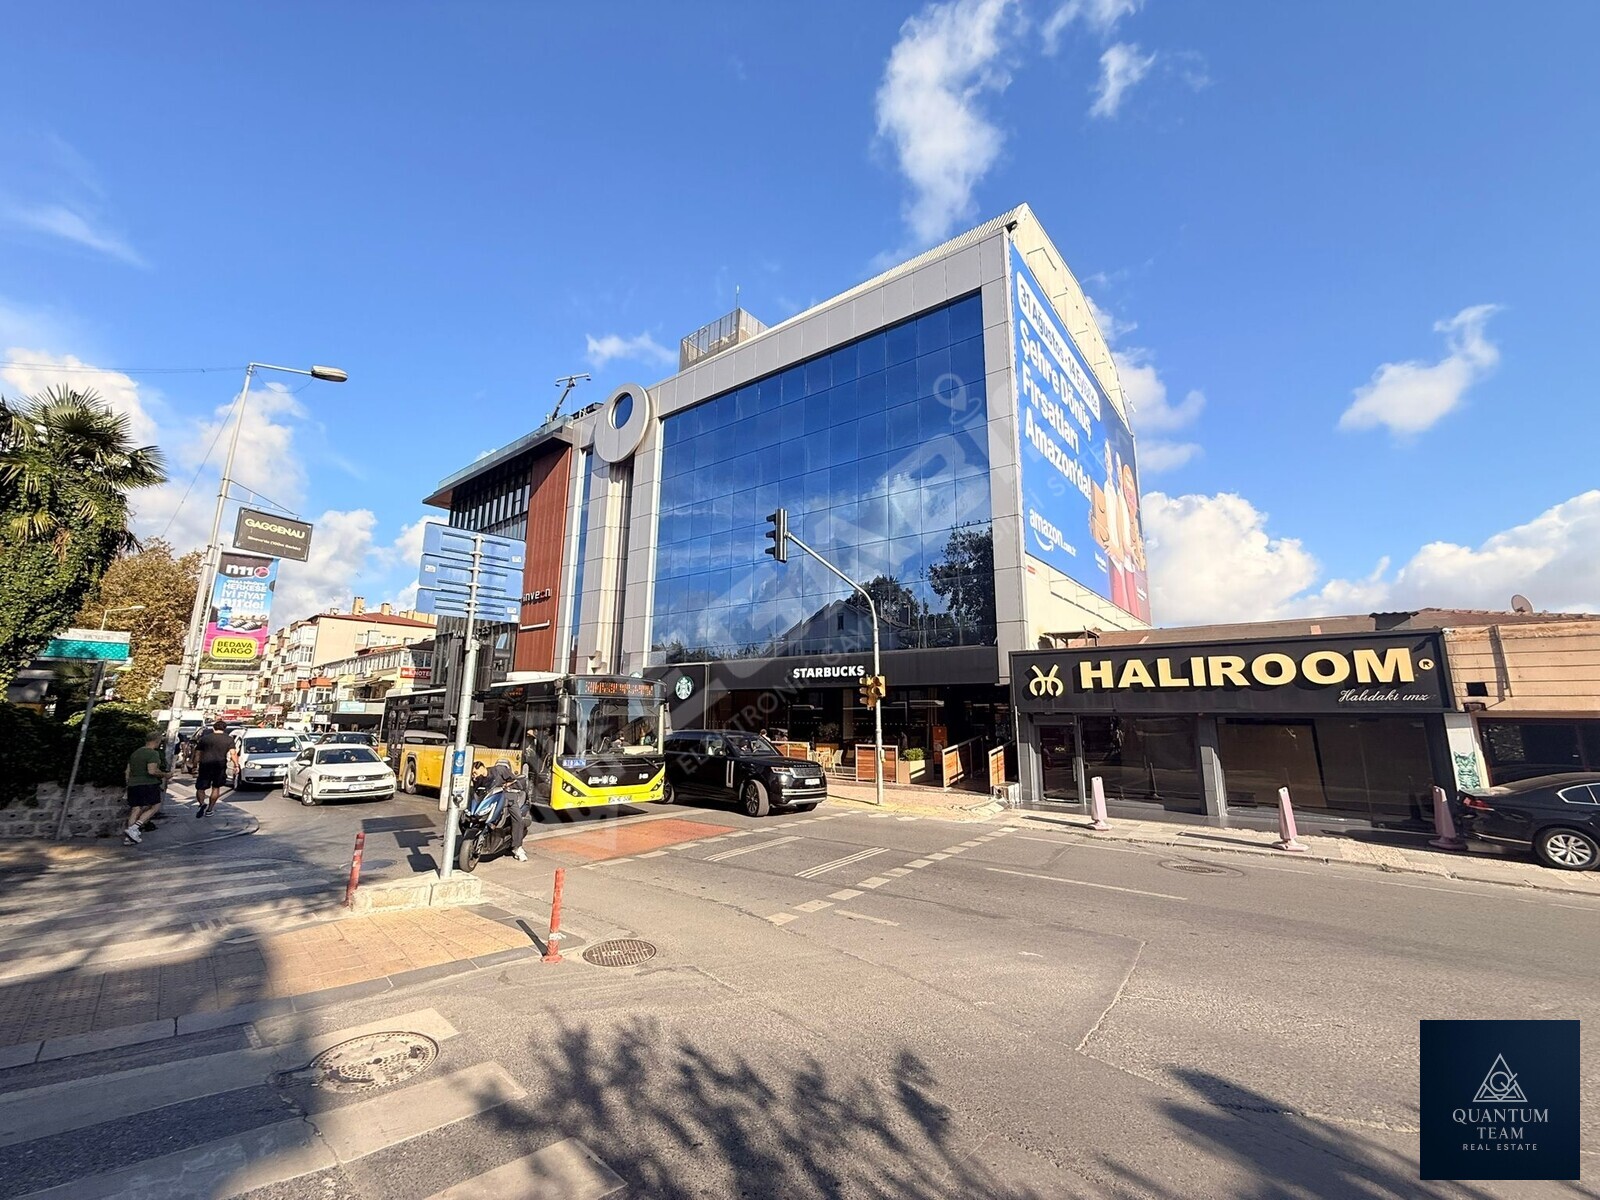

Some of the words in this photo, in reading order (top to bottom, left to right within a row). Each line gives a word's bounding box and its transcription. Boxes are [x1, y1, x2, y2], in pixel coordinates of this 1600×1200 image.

[1020, 319, 1060, 395] Şehre
[1060, 373, 1092, 442] Dönüş
[1022, 361, 1079, 455] Fırsatları
[1025, 407, 1092, 503] Amazon'da!
[245, 518, 306, 539] GAGGENAU
[223, 582, 268, 593] HERKESE
[238, 592, 267, 601] FİYAT
[216, 647, 252, 655] KARGO
[217, 641, 253, 649] BEDAVA
[793, 665, 865, 679] STARBUCKS
[1079, 647, 1415, 689] HALIROOM
